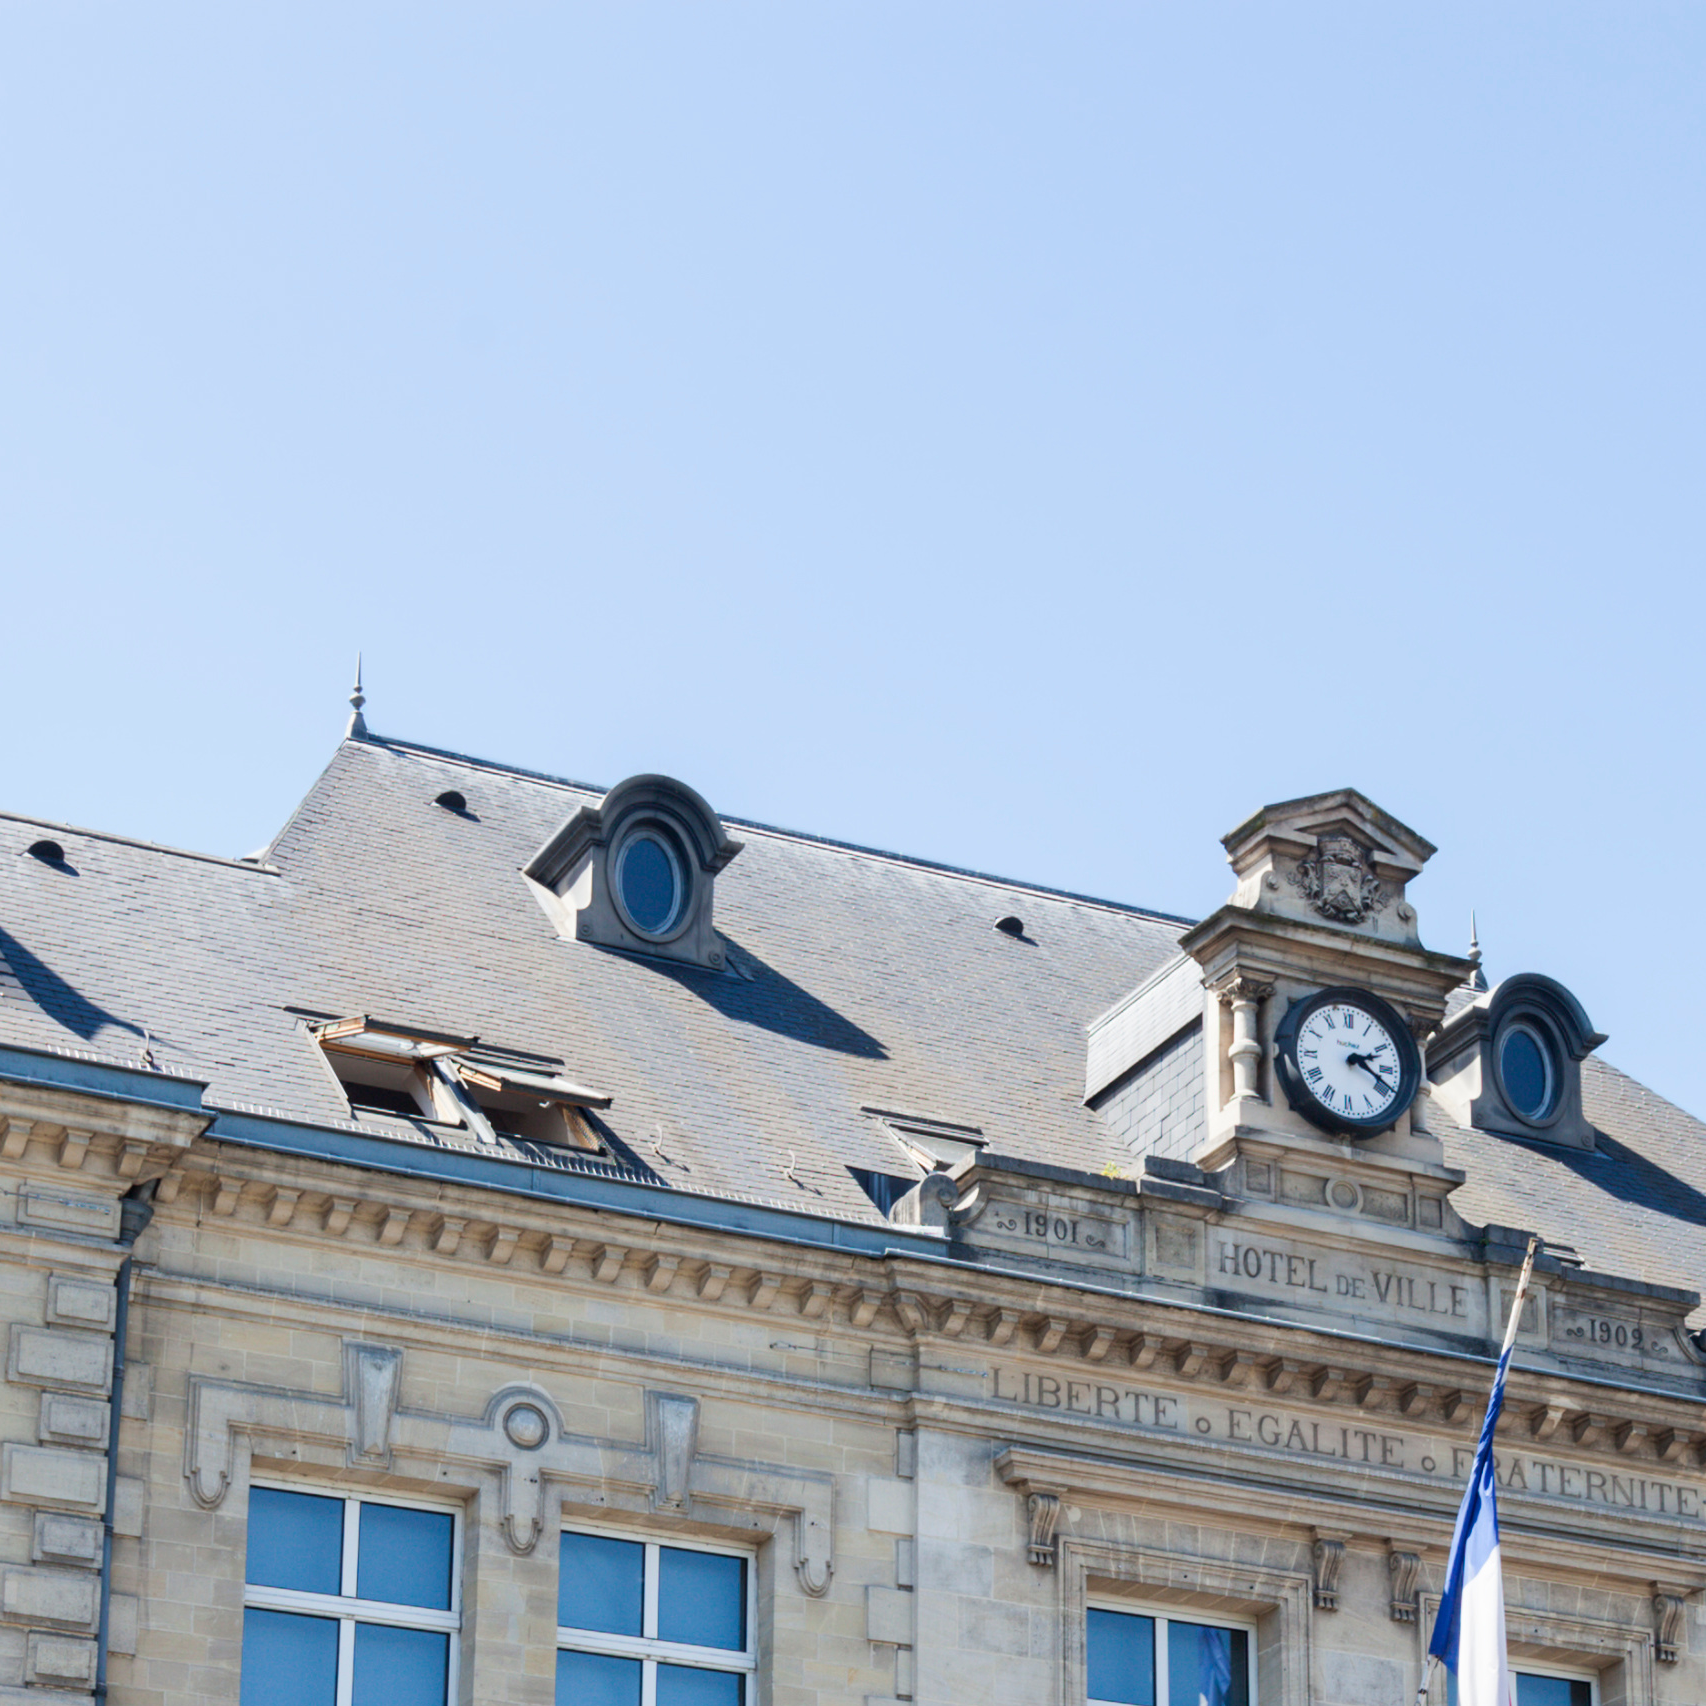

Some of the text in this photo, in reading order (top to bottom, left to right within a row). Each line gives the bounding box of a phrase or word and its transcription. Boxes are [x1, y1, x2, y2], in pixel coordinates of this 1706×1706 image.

[1024, 1211, 1079, 1245] 1901
[1218, 1240, 1469, 1318] HOTEL DE VILLE
[1589, 1318, 1644, 1350] 1902
[989, 1366, 1178, 1430] LIBERTE
[1225, 1408, 1404, 1469] EGALITE
